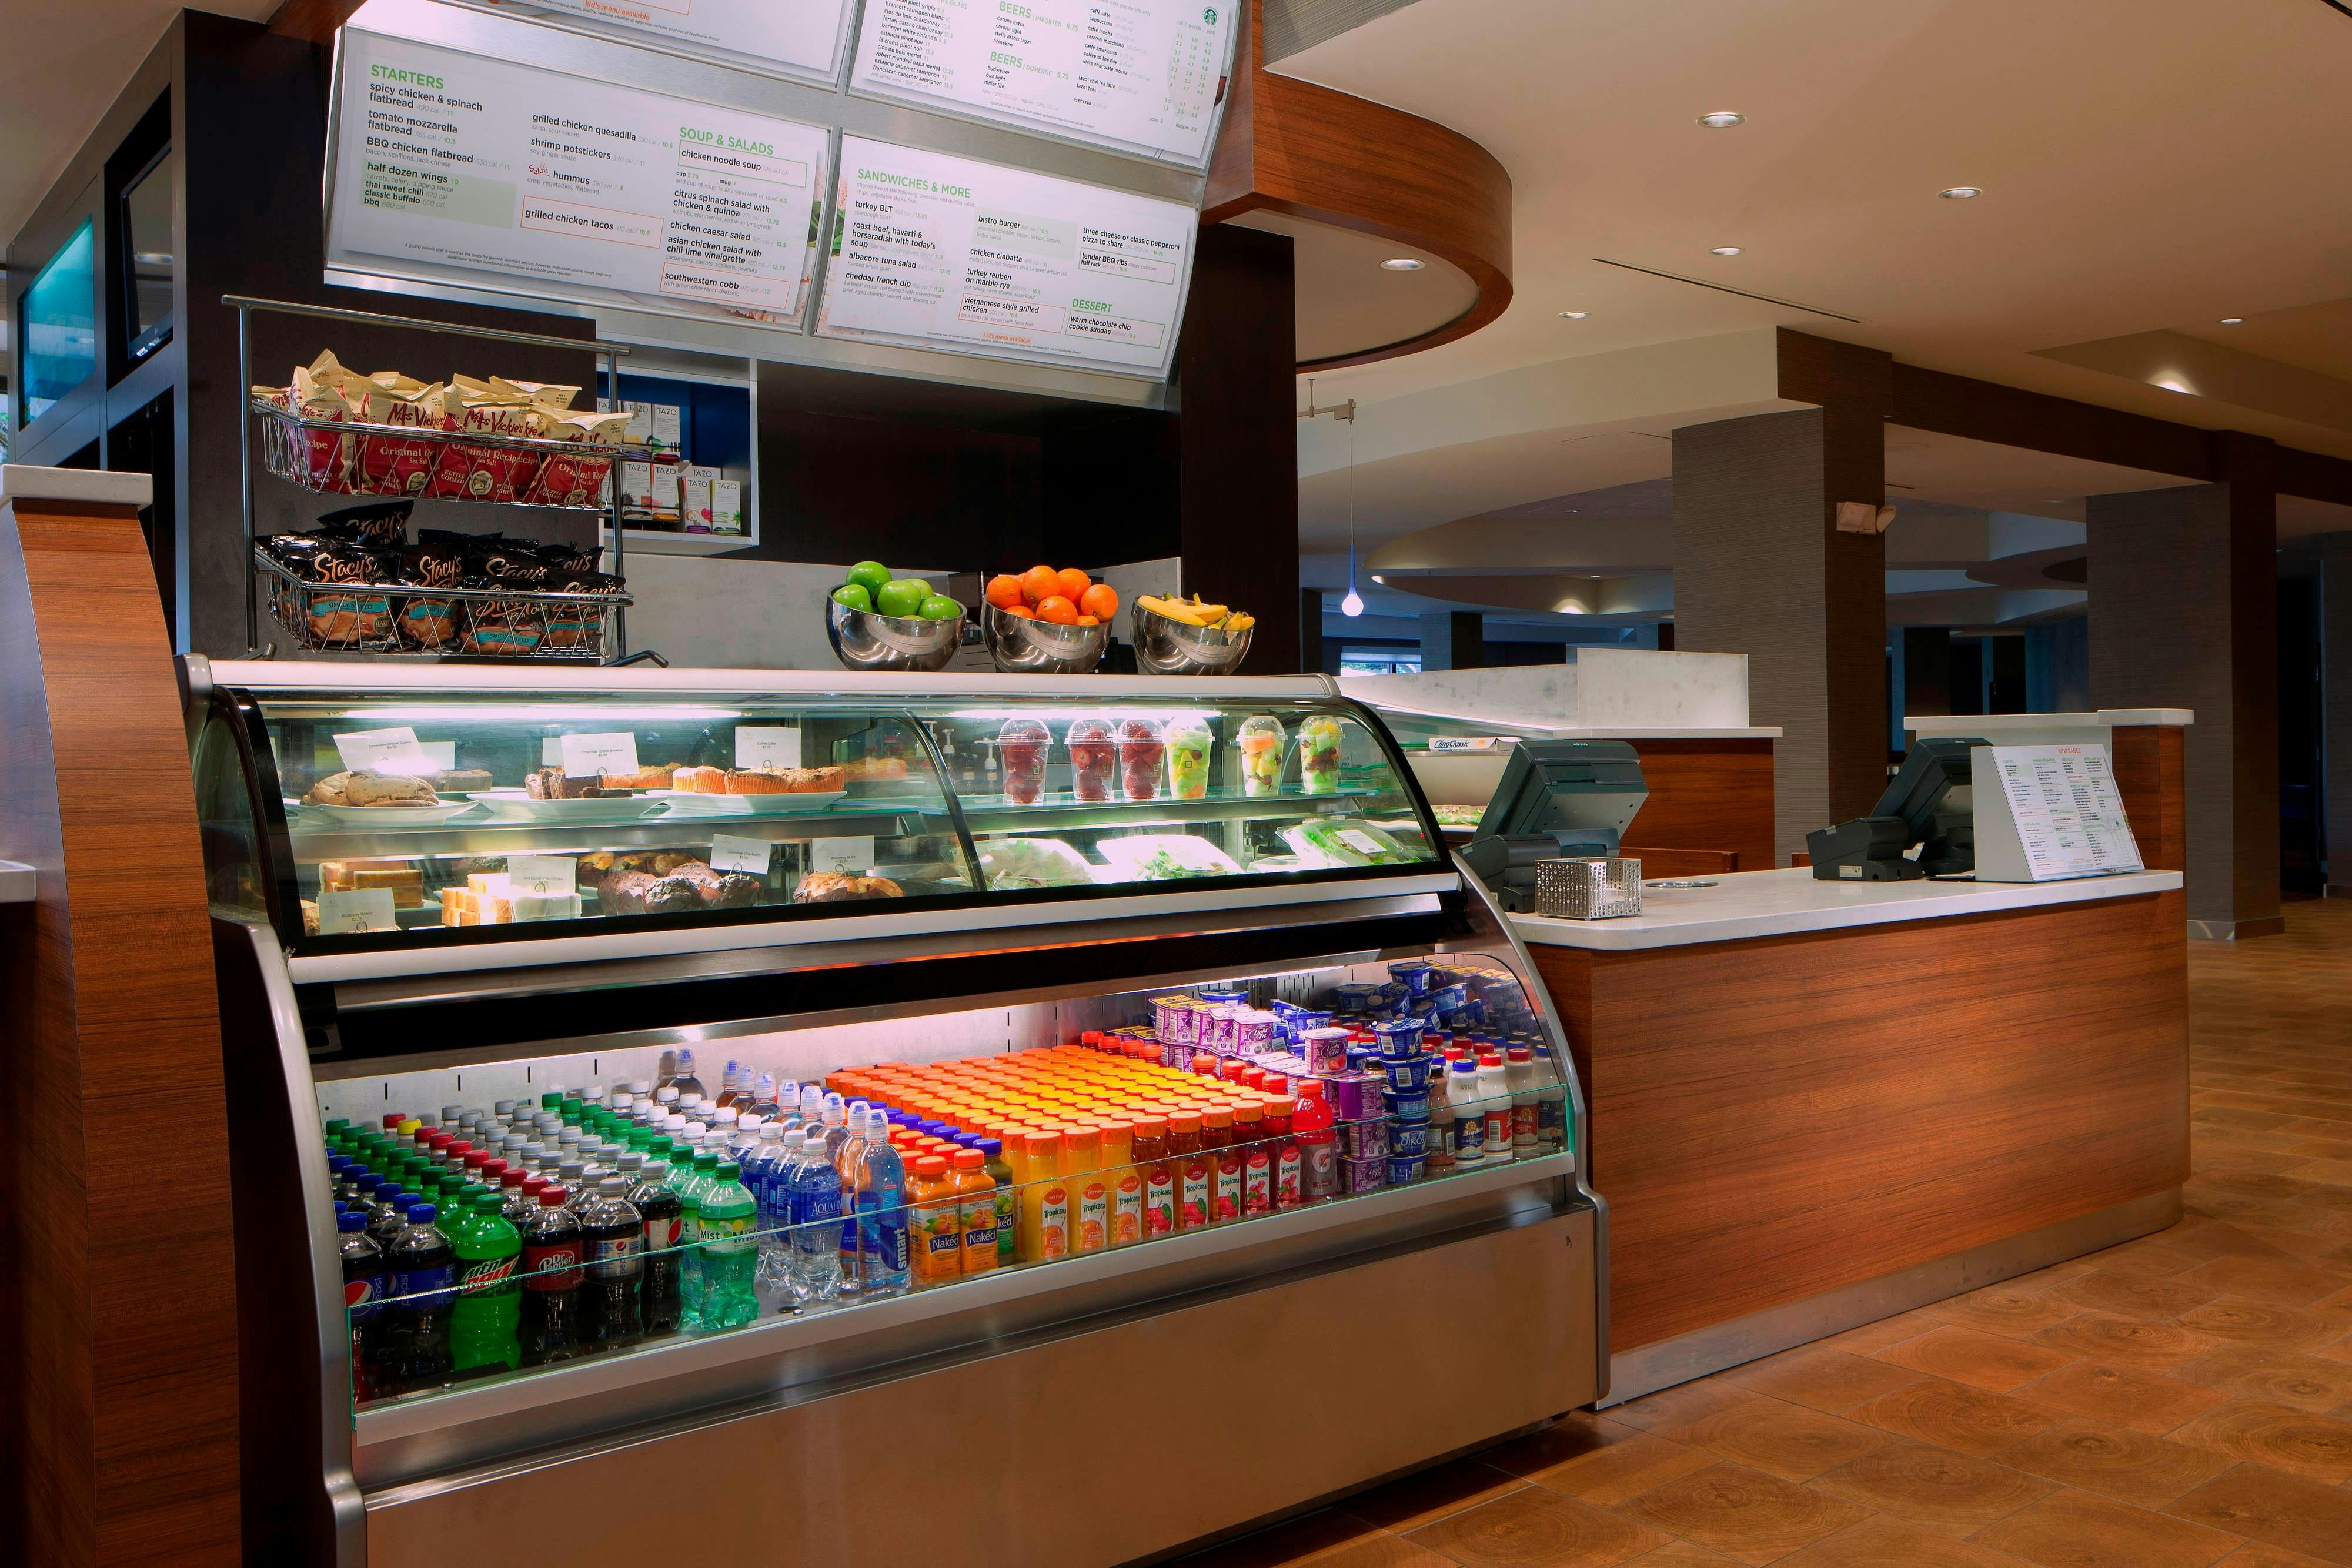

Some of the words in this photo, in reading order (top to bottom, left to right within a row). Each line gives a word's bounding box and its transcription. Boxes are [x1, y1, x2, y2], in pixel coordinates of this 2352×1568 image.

[886, 1, 906, 11] brancott
[907, 6, 930, 16] sauvignon
[1000, 1, 1031, 18] BEERS
[1035, 17, 1061, 26] IMPORTED
[1090, 17, 1112, 26] cappuccino
[994, 38, 1013, 47] heineken
[1104, 38, 1124, 48] macchiato
[892, 55, 913, 63] mondavi
[991, 51, 1022, 68] BEERS
[1026, 64, 1052, 76] DOMESTIC
[1057, 72, 1068, 80] 5.75
[372, 64, 443, 89] STARTERS
[988, 65, 1010, 75] budweiser
[370, 83, 395, 95] spicy
[399, 88, 434, 102] chicken
[437, 95, 443, 103] &
[447, 99, 482, 111] spinach
[370, 92, 413, 108] flatbread
[368, 119, 412, 136] flatbread
[369, 109, 403, 123] tomato
[406, 118, 457, 133] mozzarella
[533, 115, 559, 126] grilled
[562, 119, 593, 132] chicken
[595, 128, 636, 141] quesadilla
[680, 127, 713, 142] SOUP
[717, 135, 724, 145] &
[728, 136, 773, 155] SALADS
[367, 136, 389, 148] BBQ
[392, 142, 427, 155] chicken
[431, 147, 473, 163] flatbread
[531, 138, 560, 151] shrimp
[564, 145, 610, 159] potstickers
[682, 149, 711, 161] chicken
[714, 156, 740, 166] noodle
[743, 162, 761, 171] soup
[368, 162, 386, 172] half
[389, 166, 417, 178] dozen
[421, 172, 447, 184] wings
[529, 164, 548, 175] Sabra
[553, 170, 590, 185] hummus
[366, 180, 380, 189] thai
[383, 185, 405, 193] sweet
[408, 188, 423, 196] chili
[858, 169, 928, 190] SANDWICHES
[931, 182, 938, 192] &
[942, 184, 970, 198] MORE
[364, 198, 379, 207] bbq
[365, 189, 390, 199] classic
[393, 193, 420, 203] buffalo
[674, 189, 696, 200] citrus
[699, 195, 729, 205] spinach
[731, 200, 751, 209] salad
[754, 204, 769, 213] with
[856, 200, 877, 212] turkey
[880, 205, 893, 213] BLT
[525, 210, 553, 220] grilled
[556, 214, 588, 226] chicken
[592, 219, 613, 230] tacos
[978, 215, 997, 225] bistro
[999, 220, 1021, 229] burger
[670, 221, 700, 233] chicken
[703, 228, 728, 237] caesar
[730, 232, 750, 241] salad
[873, 224, 890, 234] beef,
[893, 227, 917, 237] havarti
[1083, 227, 1099, 235] three
[1101, 231, 1121, 240] cheese
[1130, 236, 1149, 245] classic
[1151, 240, 1180, 250] pepperoni
[849, 252, 879, 262] albacore
[882, 257, 897, 265] tuna
[970, 248, 995, 258] chicken
[997, 252, 1022, 262] ciabatta
[1082, 252, 1101, 261] tender
[1102, 256, 1115, 265] BBQ
[664, 273, 717, 286] southwestern
[720, 281, 739, 289] cobb
[846, 272, 874, 283] cheddar
[876, 276, 898, 287] french
[900, 279, 911, 289] dip
[1073, 299, 1112, 313] DESSERT
[1071, 316, 1087, 324] warm
[1088, 319, 1117, 329] chocolate
[380, 447, 421, 457] Original
[441, 474, 465, 484] COOKED
[315, 553, 375, 584] Stacy's
[420, 555, 462, 587] Stacy's
[1435, 740, 1470, 748] ClingClassic
[1248, 1171, 1268, 1181] Tropicana
[1282, 1165, 1299, 1174] Tropicana
[1185, 1184, 1207, 1193] Tropicana
[1220, 1178, 1240, 1188] Tropicana
[1119, 1195, 1140, 1205] Tropicana
[1150, 1189, 1172, 1199] Tropicana
[1044, 1208, 1066, 1218] Tropicana
[1083, 1203, 1105, 1213] Tropicana
[701, 1229, 720, 1239] Mist
[894, 1228, 907, 1269] smart
[543, 1255, 573, 1271] Pepper
[553, 1253, 566, 1265] Dr
